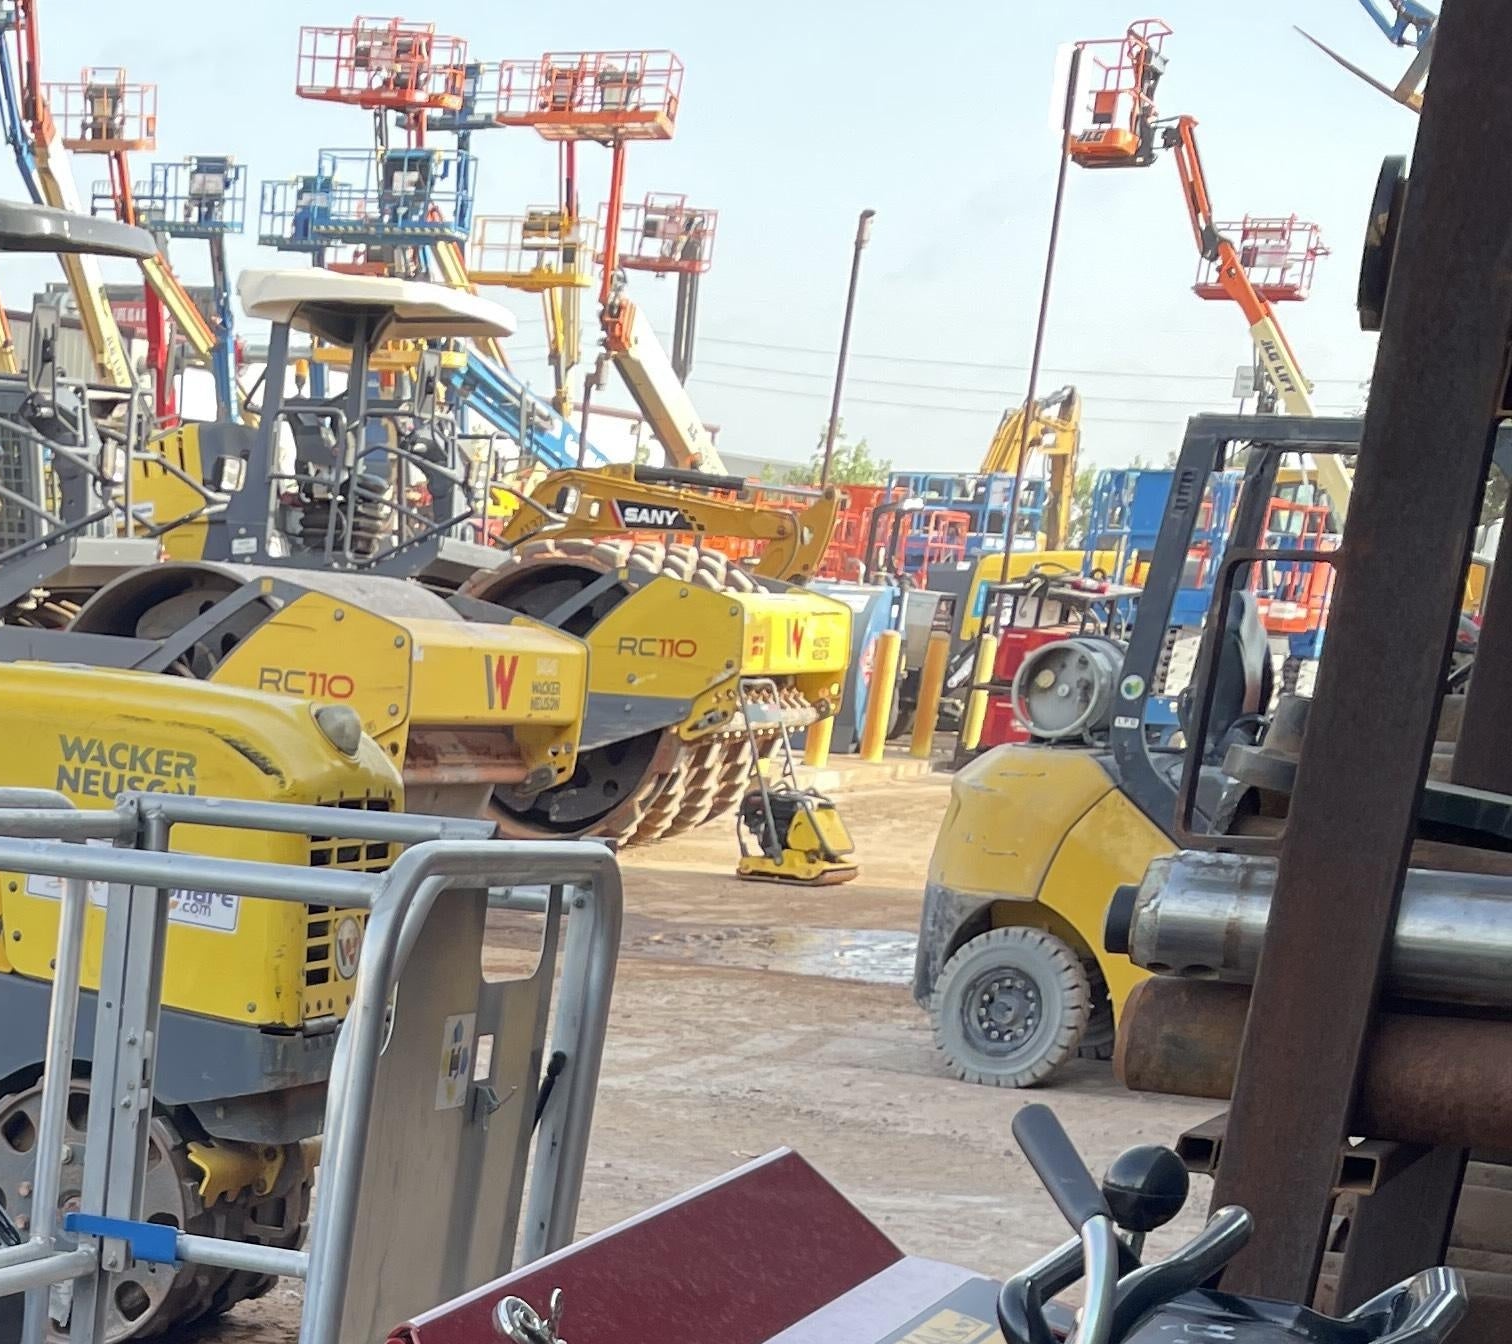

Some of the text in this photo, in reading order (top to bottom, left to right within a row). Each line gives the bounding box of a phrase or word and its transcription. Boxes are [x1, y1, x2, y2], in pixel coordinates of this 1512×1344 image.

[1076, 130, 1107, 142] JLG
[624, 507, 679, 525] SANY
[616, 637, 697, 659] RC110
[259, 667, 355, 699] RC110
[58, 734, 199, 780] WACKER
